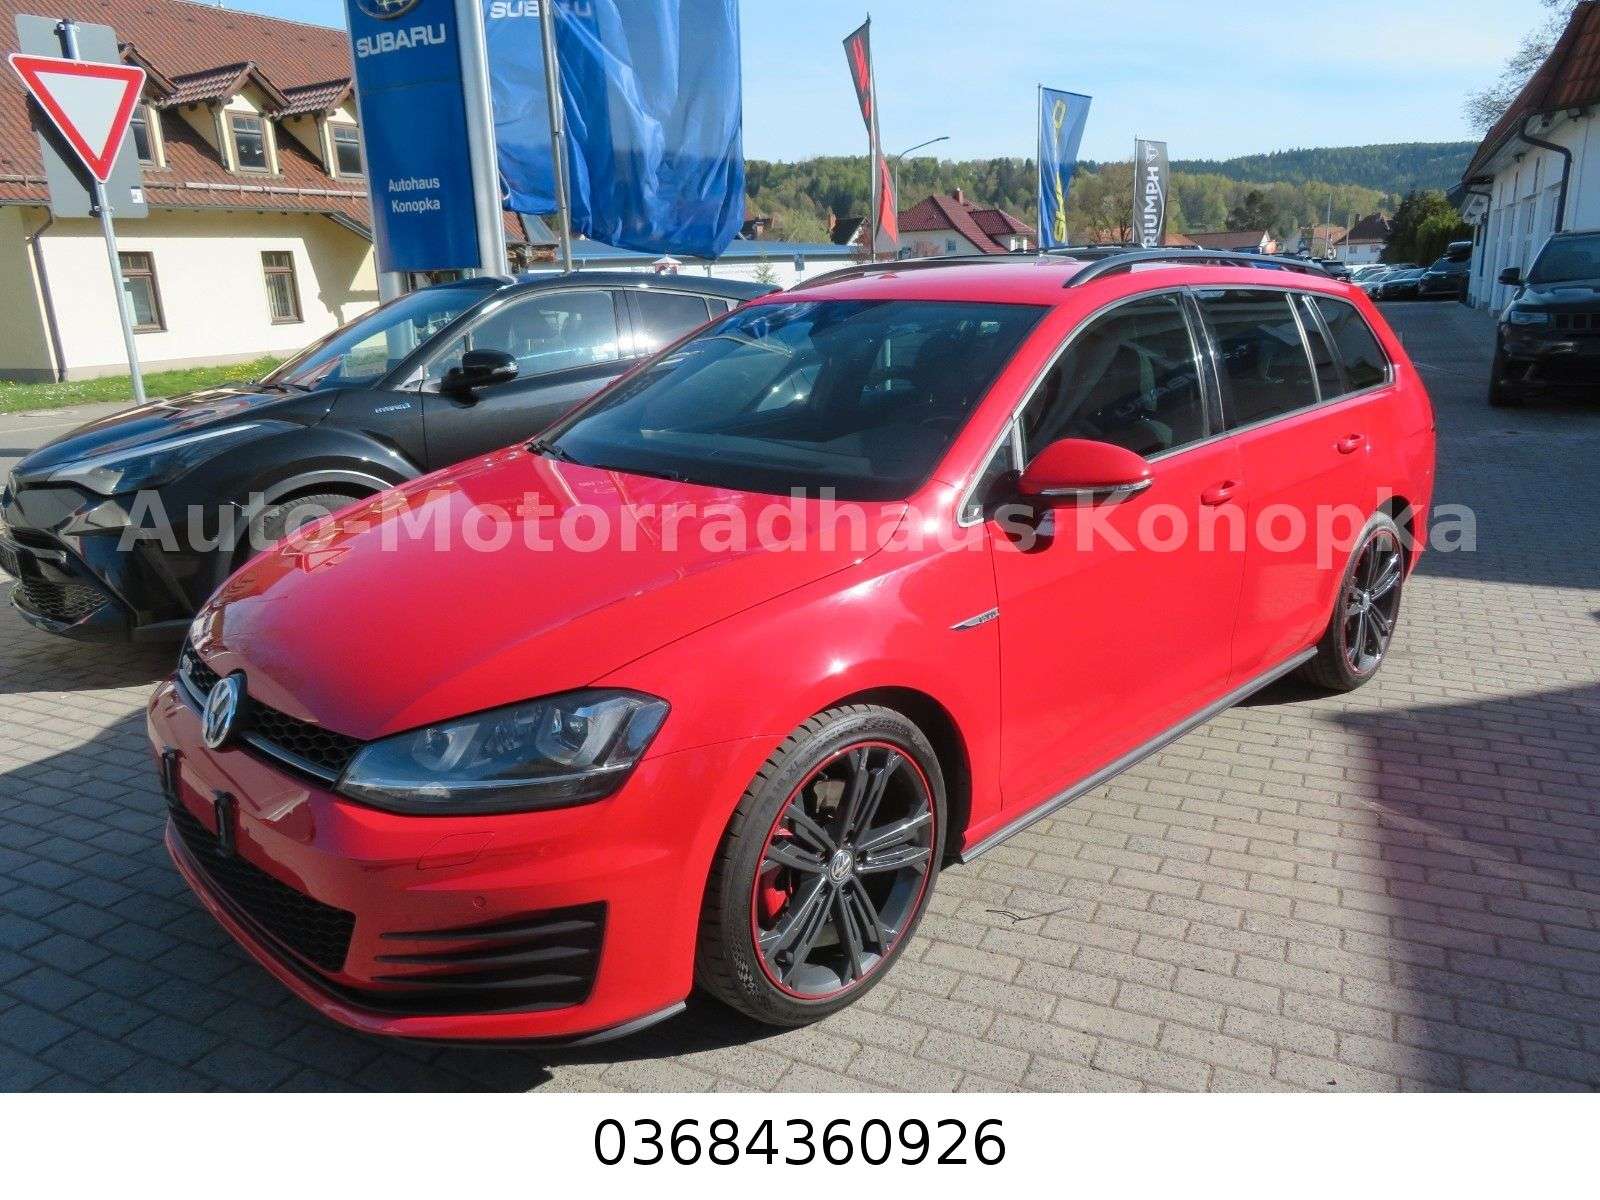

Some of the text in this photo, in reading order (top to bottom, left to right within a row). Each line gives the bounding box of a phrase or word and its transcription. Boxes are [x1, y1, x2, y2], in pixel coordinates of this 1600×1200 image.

[356, 23, 446, 58] SUBARU
[388, 177, 441, 192] Autohaus
[391, 197, 441, 214] Konopka
[1143, 165, 1161, 247] RIUMPH
